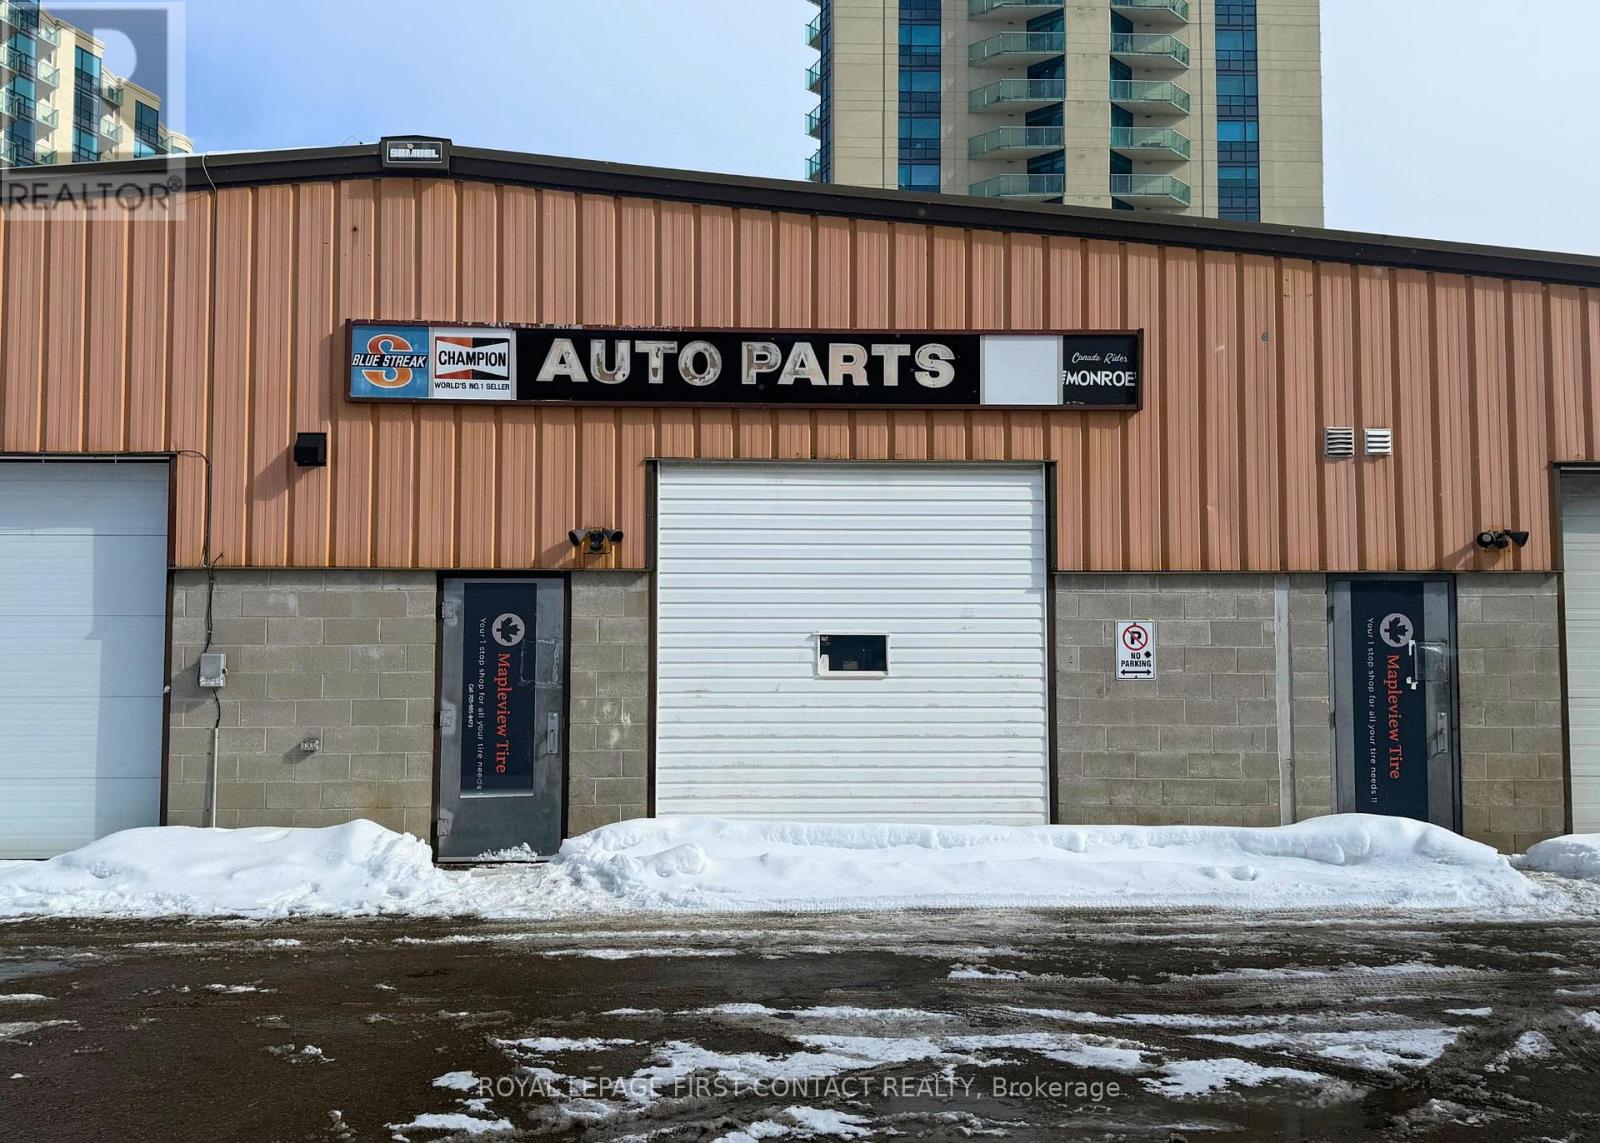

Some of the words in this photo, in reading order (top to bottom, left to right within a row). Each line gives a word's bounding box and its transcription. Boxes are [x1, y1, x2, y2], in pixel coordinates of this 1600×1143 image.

[352, 354, 381, 367] BLUE
[382, 355, 427, 368] STREAK
[438, 350, 507, 367] CHAMPION
[536, 337, 723, 387] AUTO
[741, 341, 956, 389] PARTS
[1071, 352, 1101, 364] Canada
[434, 382, 467, 390] WORLD'S
[485, 383, 510, 391] SELLER
[1065, 370, 1136, 387] MONROE
[479, 617, 487, 637] Your
[1366, 617, 1375, 638] Your
[477, 646, 486, 666] stop
[1121, 660, 1152, 668] PARKING
[1131, 652, 1141, 660] NO
[1366, 647, 1375, 668] stop
[476, 668, 486, 690] shop
[1366, 670, 1375, 693] shop
[478, 692, 486, 705] for
[493, 652, 512, 737] Mapleview
[1368, 695, 1376, 709] for
[1384, 654, 1403, 742] Mapleview
[477, 707, 486, 718] all
[1368, 710, 1377, 722] all
[475, 720, 484, 740] your
[1367, 724, 1377, 745] your
[477, 743, 485, 759] tire
[495, 740, 510, 774] Tire
[1370, 748, 1378, 764] tire
[1388, 744, 1403, 780] Tire
[476, 761, 484, 790] needs
[1369, 766, 1378, 795] needs
